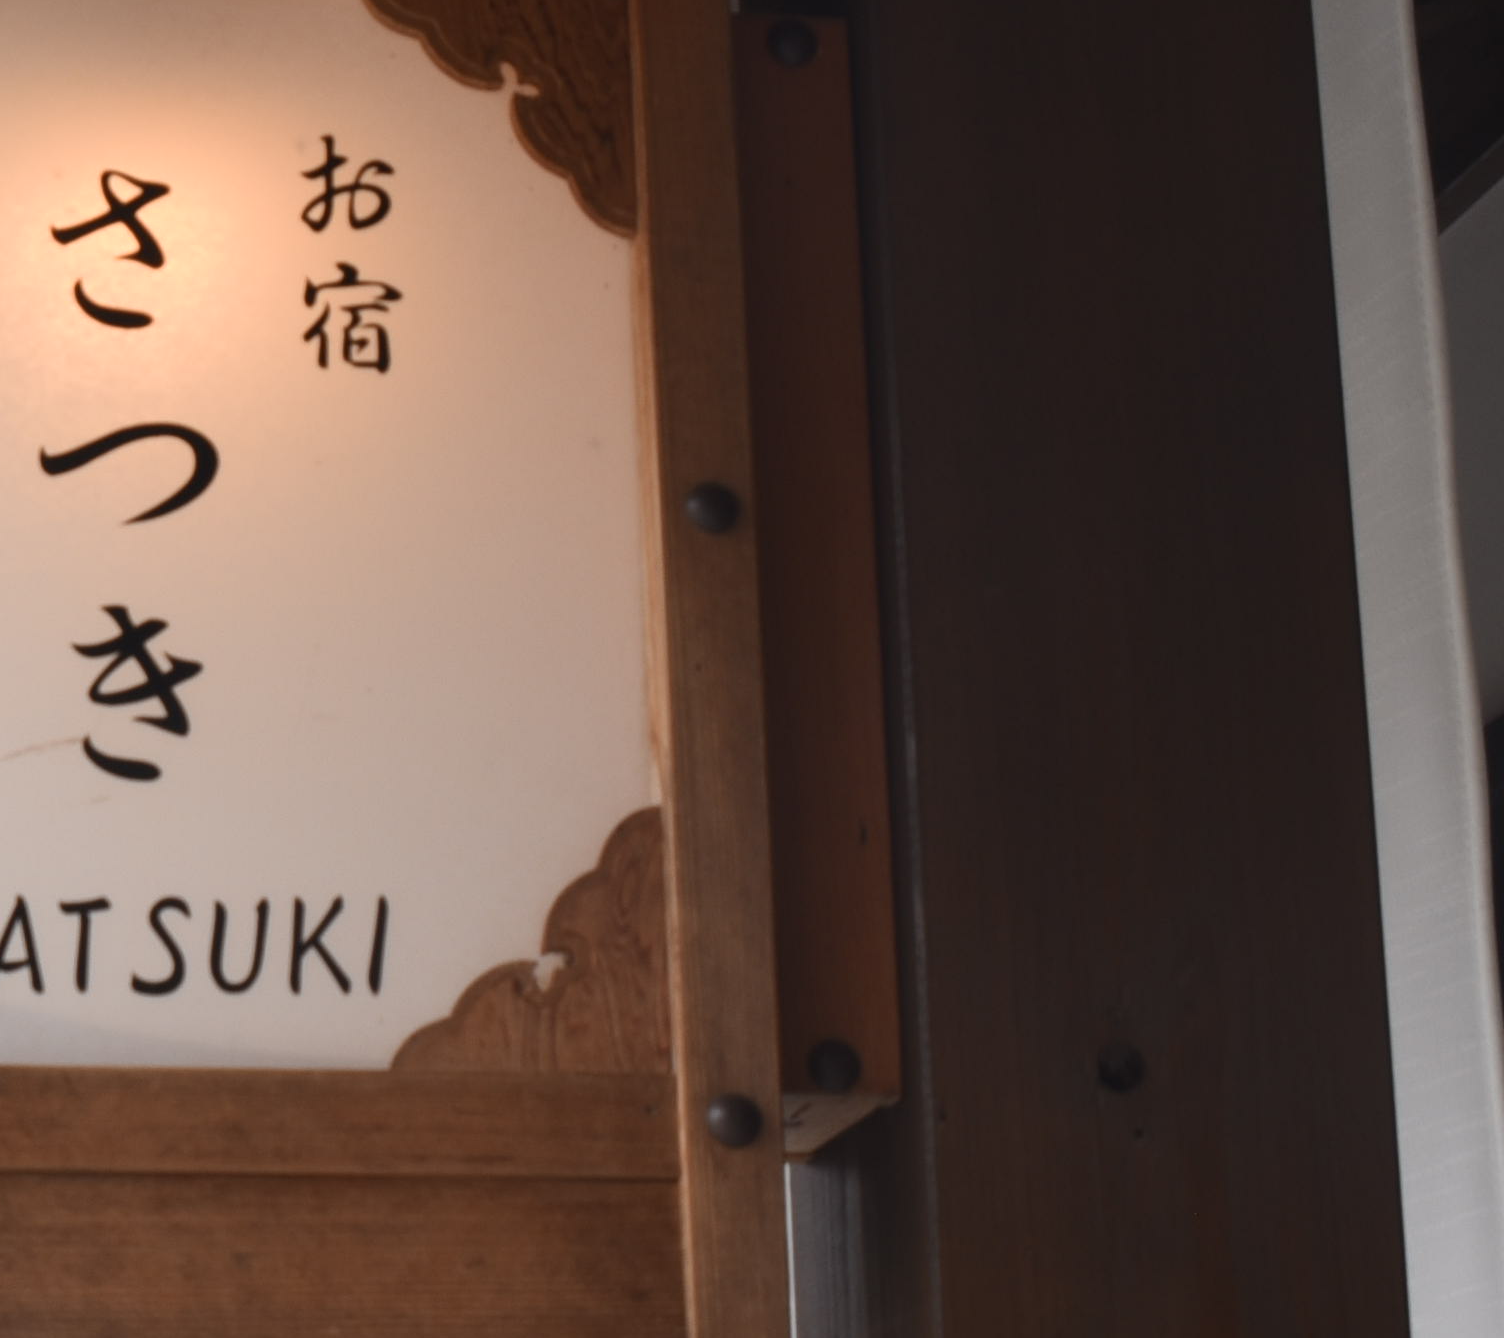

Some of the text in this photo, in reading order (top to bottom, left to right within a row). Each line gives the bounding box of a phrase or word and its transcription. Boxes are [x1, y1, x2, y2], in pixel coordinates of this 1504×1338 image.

[302, 135, 402, 373] お宿
[40, 172, 218, 781] さつき
